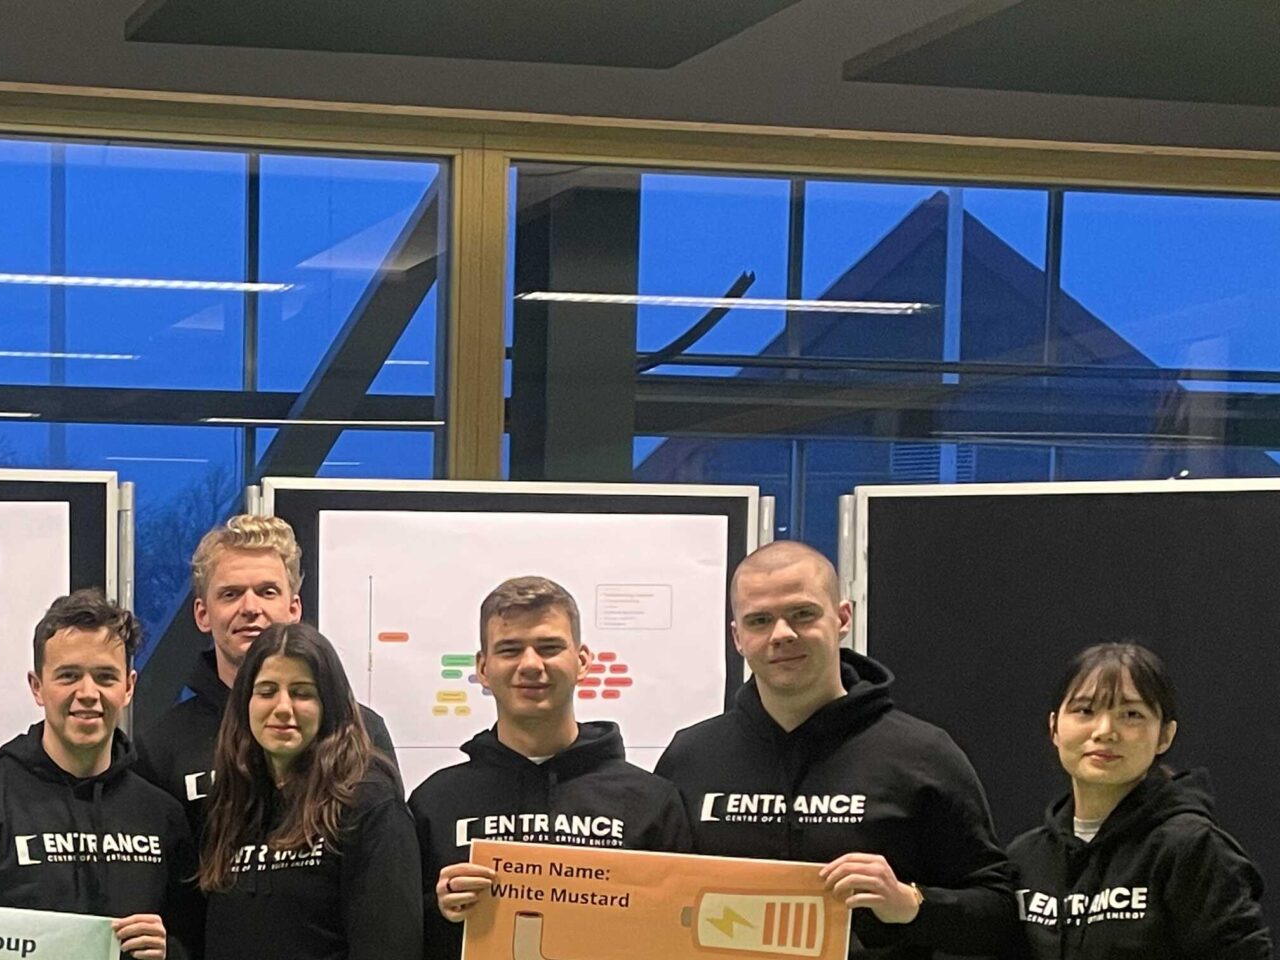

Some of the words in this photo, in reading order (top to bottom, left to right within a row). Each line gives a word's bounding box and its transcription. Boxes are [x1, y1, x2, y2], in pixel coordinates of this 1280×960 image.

[727, 793, 867, 815] ENTRANCE
[485, 813, 624, 839] ENTRANCE
[43, 832, 162, 855] ENTRANCE
[493, 857, 543, 876] Team
[549, 861, 611, 881] Name:
[491, 883, 545, 901] White
[550, 887, 630, 908] Mustard
